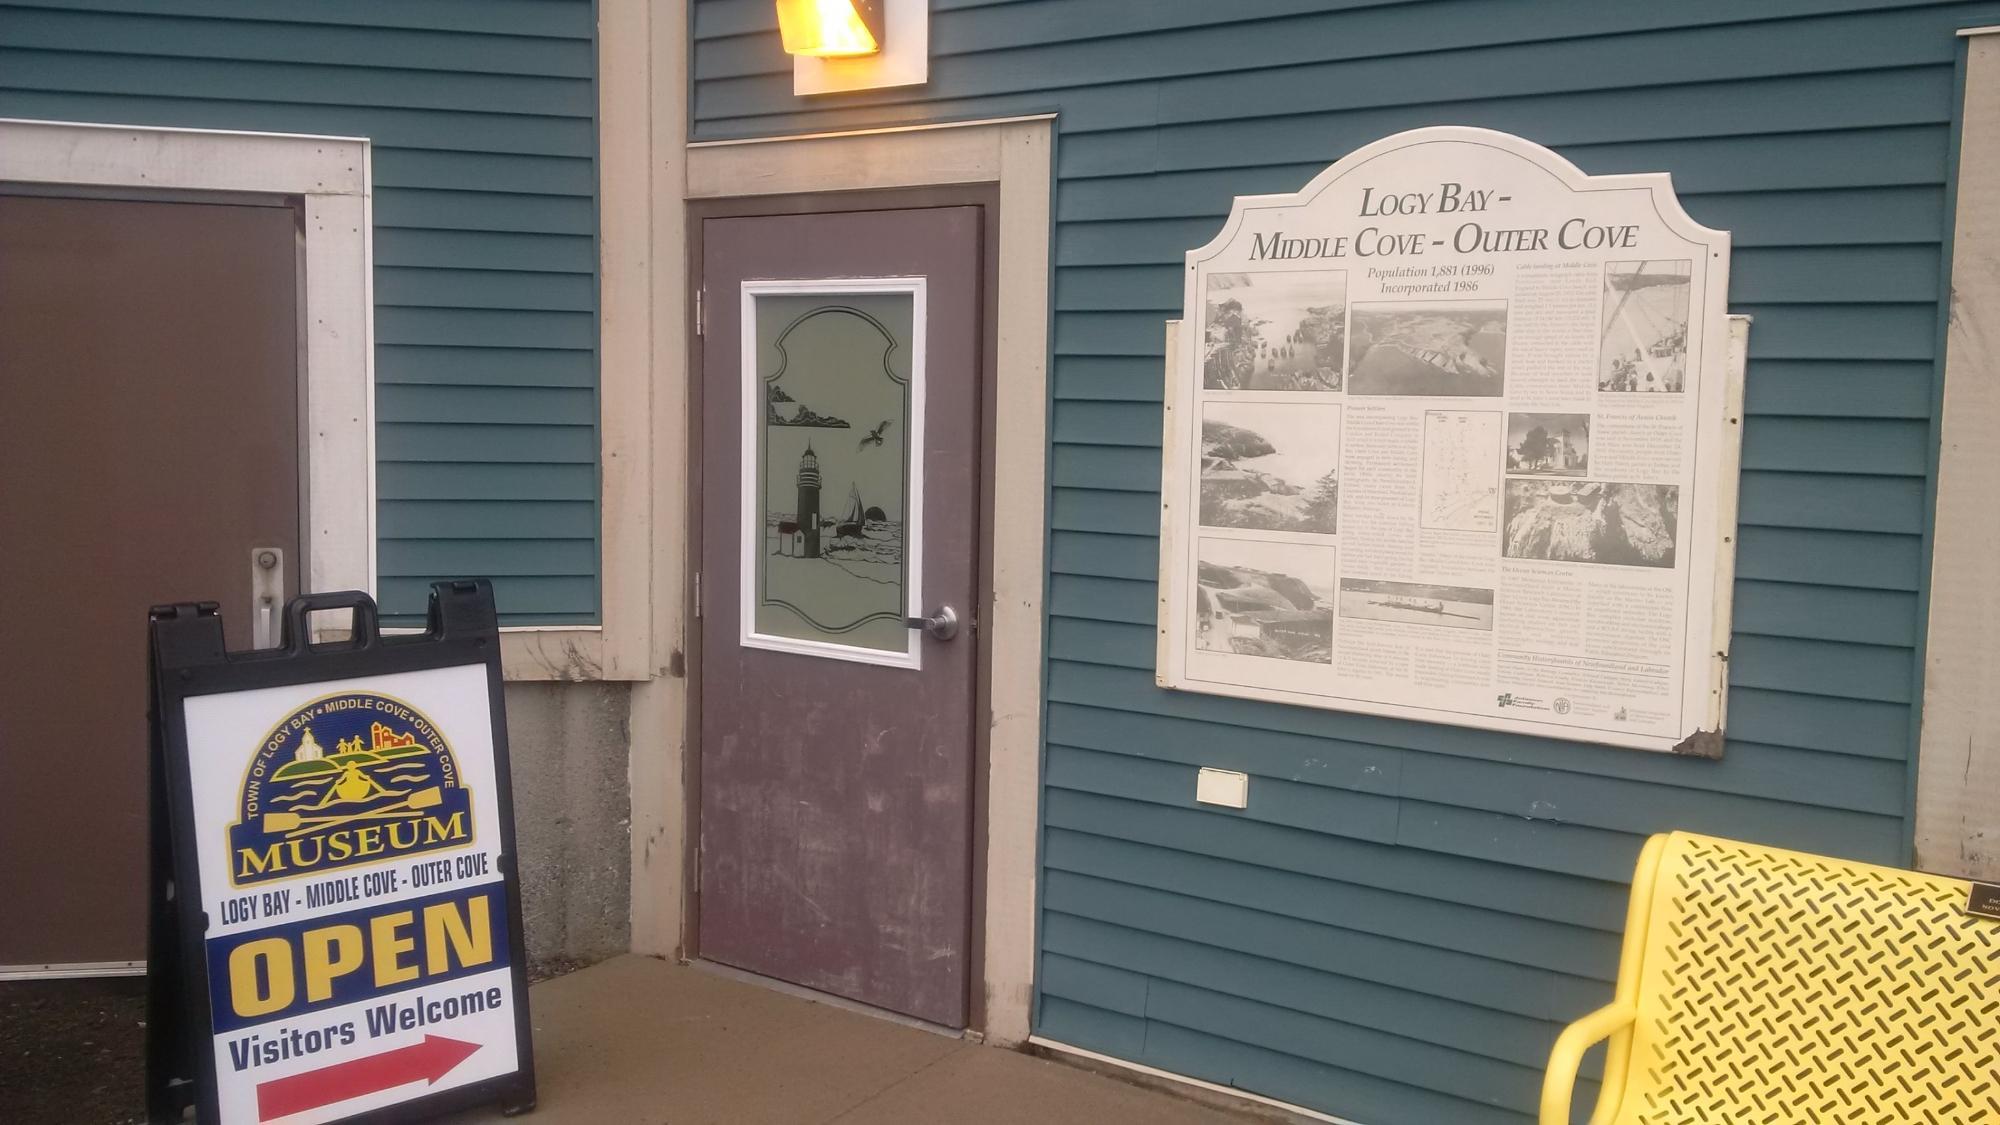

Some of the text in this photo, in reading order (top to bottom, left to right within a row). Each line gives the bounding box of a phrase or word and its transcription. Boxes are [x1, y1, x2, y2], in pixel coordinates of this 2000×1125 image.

[1359, 187, 1434, 217] LOGY
[1436, 182, 1494, 213] BAY
[1248, 232, 1348, 261] MIDDLE
[1354, 227, 1426, 257] COVE
[1453, 222, 1549, 254] OUTER
[1558, 218, 1640, 250] COVE
[1368, 263, 1494, 281] Population 1,881 (1996)
[1381, 281, 1479, 296] Incorporated 1986
[247, 698, 455, 820] TOWN OF LOGY BAY MIDDLE COVE OUTER COVE
[236, 811, 468, 878] MUSEUM
[221, 895, 258, 926] LOGY
[263, 889, 291, 918] BAY
[306, 876, 360, 910] MIDDLE
[363, 869, 398, 898] COVE
[411, 859, 452, 889] OUTER
[456, 852, 489, 880] COVE
[228, 895, 493, 1018] OPEN
[228, 987, 502, 1072] Visitors Welcome
